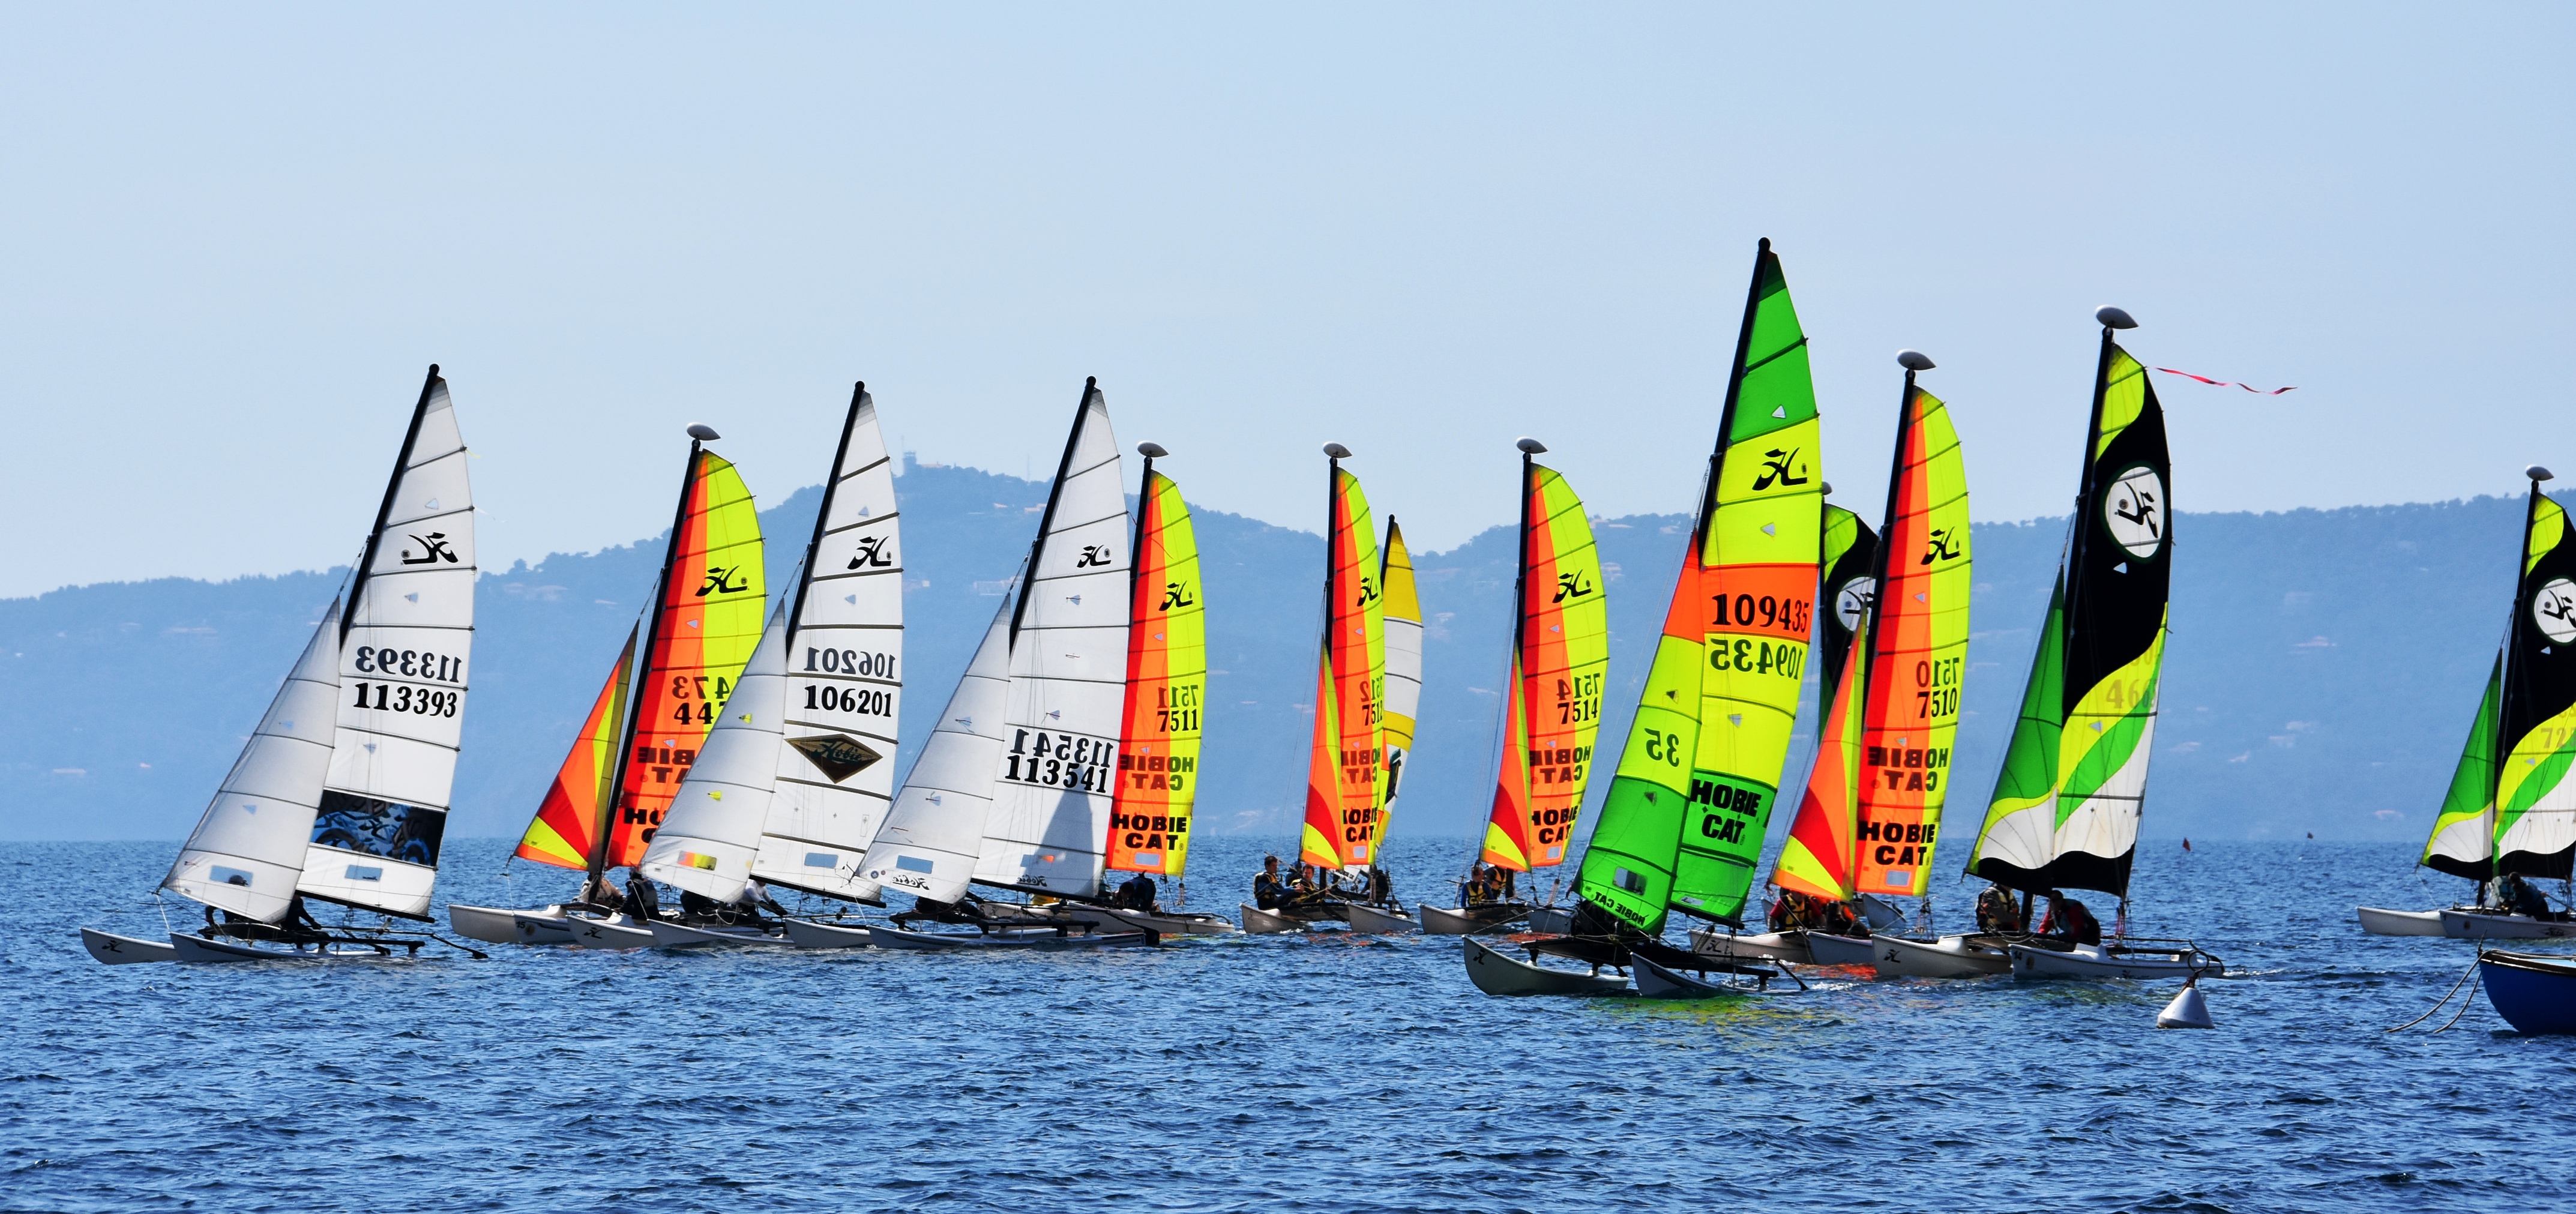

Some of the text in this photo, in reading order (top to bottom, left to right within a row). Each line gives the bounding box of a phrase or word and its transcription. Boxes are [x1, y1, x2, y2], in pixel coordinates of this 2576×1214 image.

[1711, 593, 1810, 633] 109435
[353, 682, 457, 718] 113393
[804, 685, 891, 717] 106201
[1557, 697, 1598, 724] 7514
[1917, 687, 1957, 718] 7510
[1157, 708, 1199, 732] 7511
[1005, 754, 1107, 793] 113541
[1690, 778, 1762, 817] HOBIE
[1111, 813, 1187, 832] HOBIE
[1346, 825, 1374, 843] CAT
[1538, 823, 1572, 844] CAT
[1702, 813, 1746, 844] CAT
[1858, 820, 1936, 844] HOBIE
[1125, 832, 1179, 850] CAT
[1874, 844, 1928, 866] CAT
